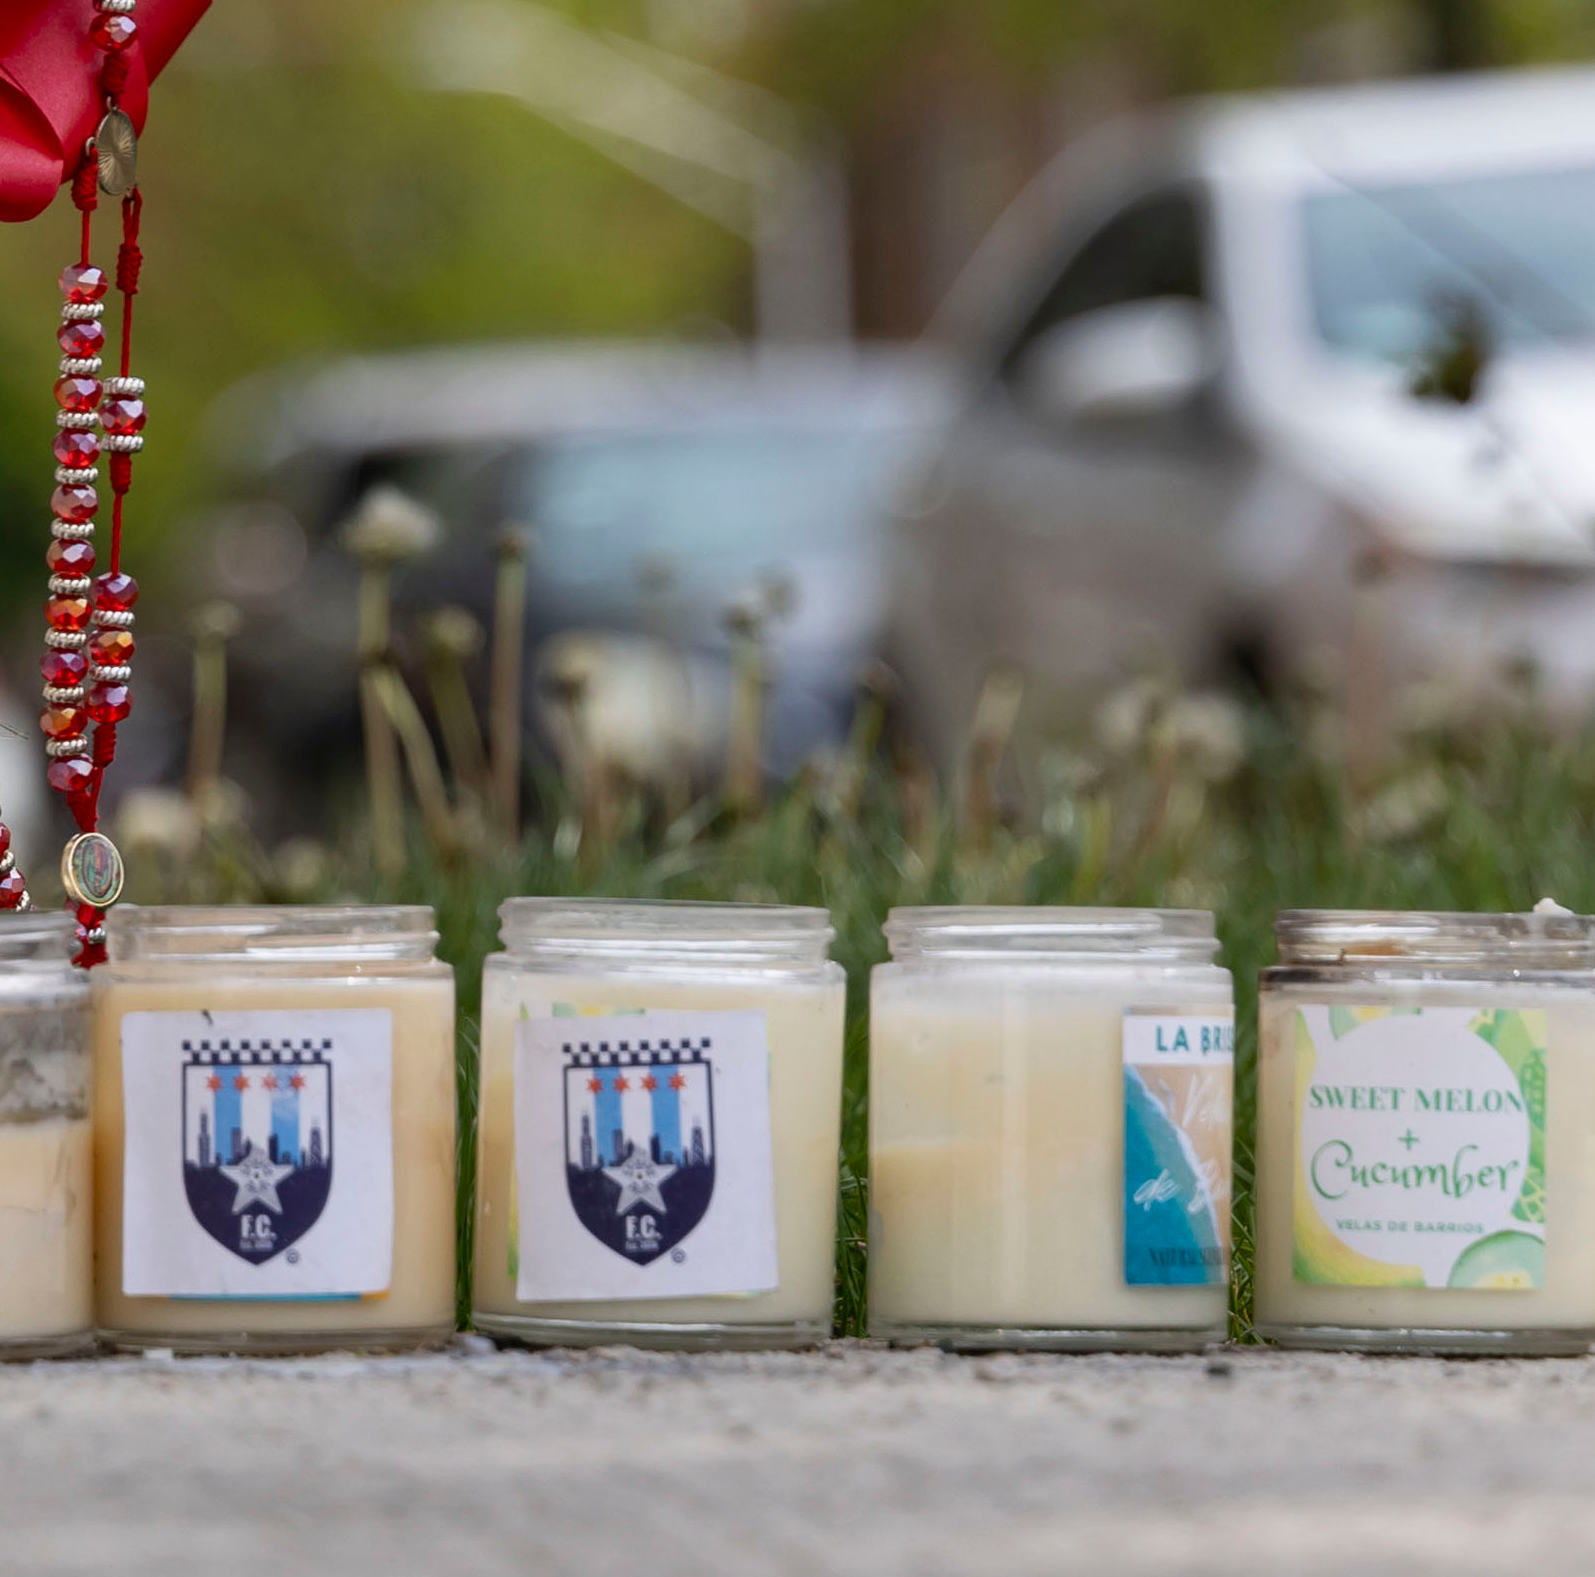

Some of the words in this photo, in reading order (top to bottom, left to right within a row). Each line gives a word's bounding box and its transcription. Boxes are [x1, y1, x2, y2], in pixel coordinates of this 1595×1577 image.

[1156, 1026, 1189, 1052] LA
[1309, 1084, 1406, 1111] SWEET
[1414, 1087, 1524, 1113] MELON
[1397, 1128, 1421, 1151] +
[1310, 1139, 1520, 1200] Cucumber
[1335, 1218, 1382, 1233] VELAS
[1387, 1220, 1407, 1233] DE
[1413, 1220, 1485, 1234] BARRIOS
